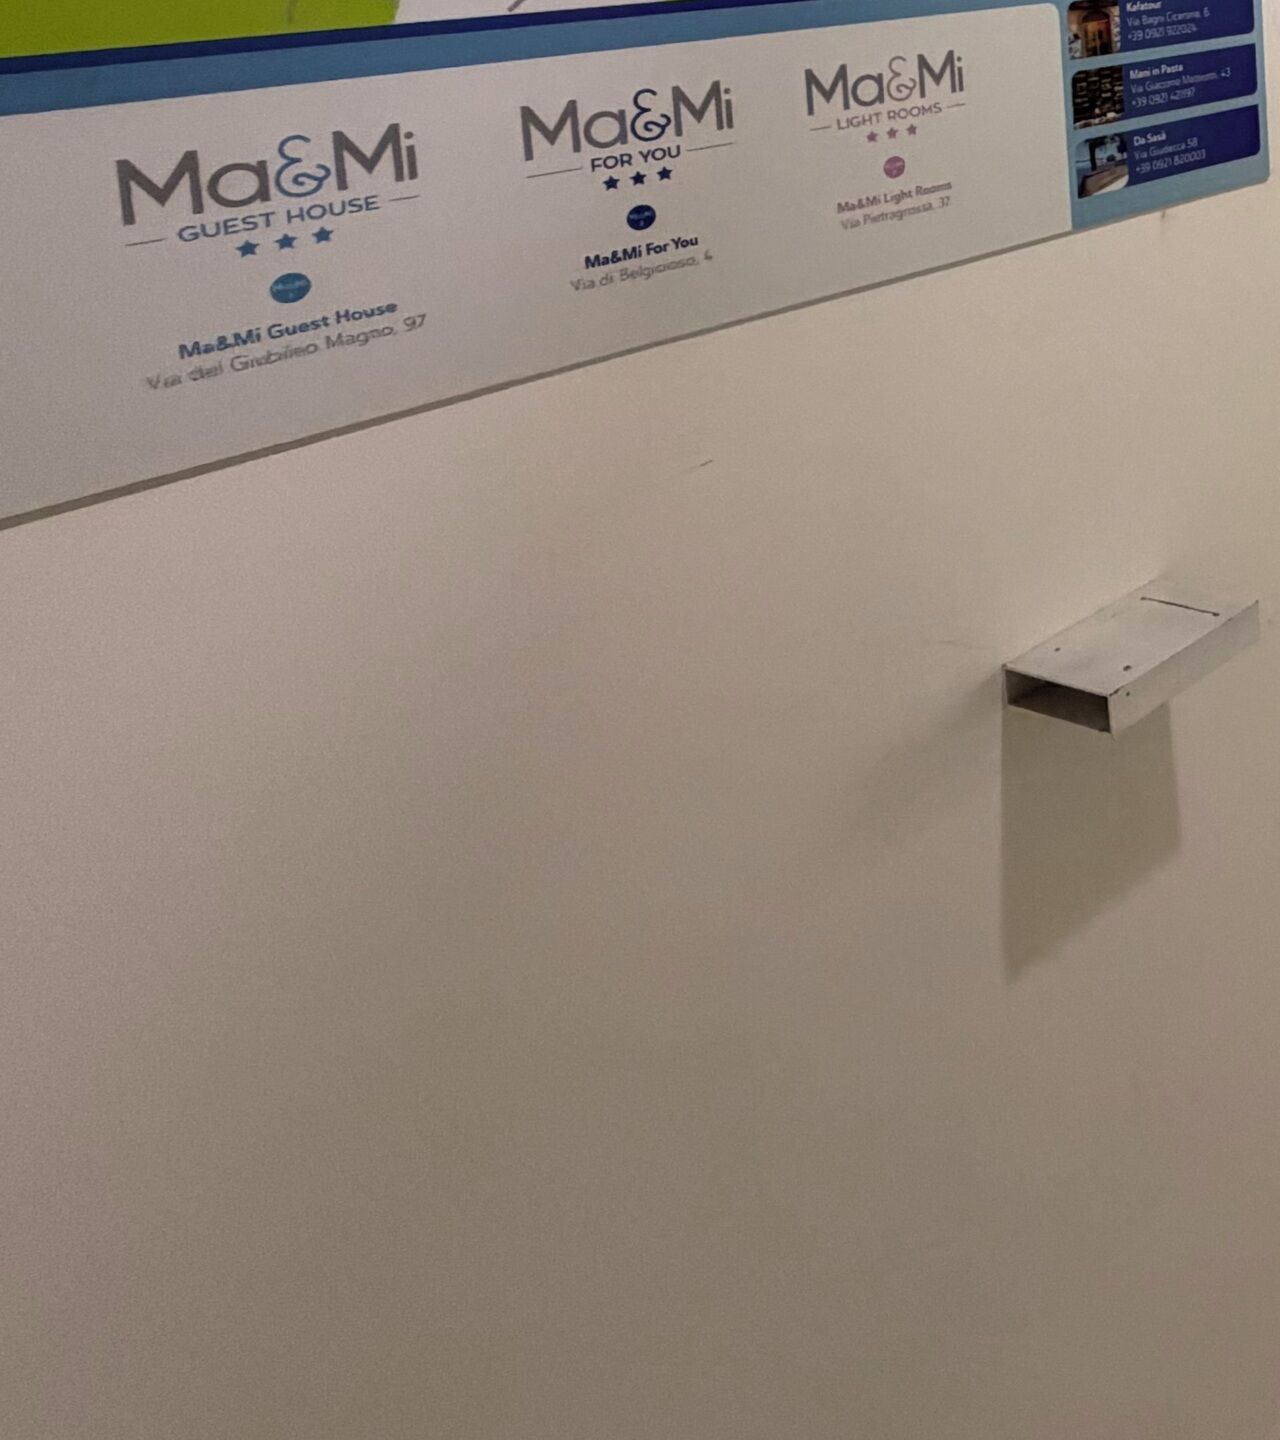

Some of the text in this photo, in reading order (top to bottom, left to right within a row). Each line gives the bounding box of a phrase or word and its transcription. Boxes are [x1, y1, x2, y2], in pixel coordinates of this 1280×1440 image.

[1127, 17, 1140, 26] Via
[1142, 14, 1164, 25] Bagni
[1128, 30, 1142, 41] +39
[1145, 27, 1164, 39] 0921
[805, 50, 964, 116] Ma&Mi
[1130, 64, 1183, 80] Mani in Pasta
[1131, 83, 1143, 94] Via
[1145, 79, 1181, 91] Giacomo
[1132, 97, 1147, 108] +39
[1149, 93, 1167, 105] 0921
[520, 80, 734, 161] Ma&Mi
[837, 102, 942, 130] LIGHT ROOMS
[1134, 136, 1146, 146] Da
[1134, 151, 1147, 160] Via
[1150, 143, 1186, 157] Giudecca
[591, 145, 681, 172] FOR YOU
[1136, 163, 1150, 174] +39
[1152, 159, 1172, 170] 0921
[116, 123, 418, 226] Ma&Mi
[837, 182, 952, 213] Ma&Mi Light Rooms
[177, 195, 381, 243] GUEST HOUSE
[841, 219, 861, 230] Via
[585, 236, 698, 269] Ma&Mi For You
[570, 279, 595, 291] Via
[600, 274, 614, 286] di
[178, 302, 398, 360] Ma&Mi Guest House
[146, 373, 182, 390] Via
[188, 362, 224, 381] del
[230, 342, 318, 371] Giubileo
[403, 314, 426, 332] 97
